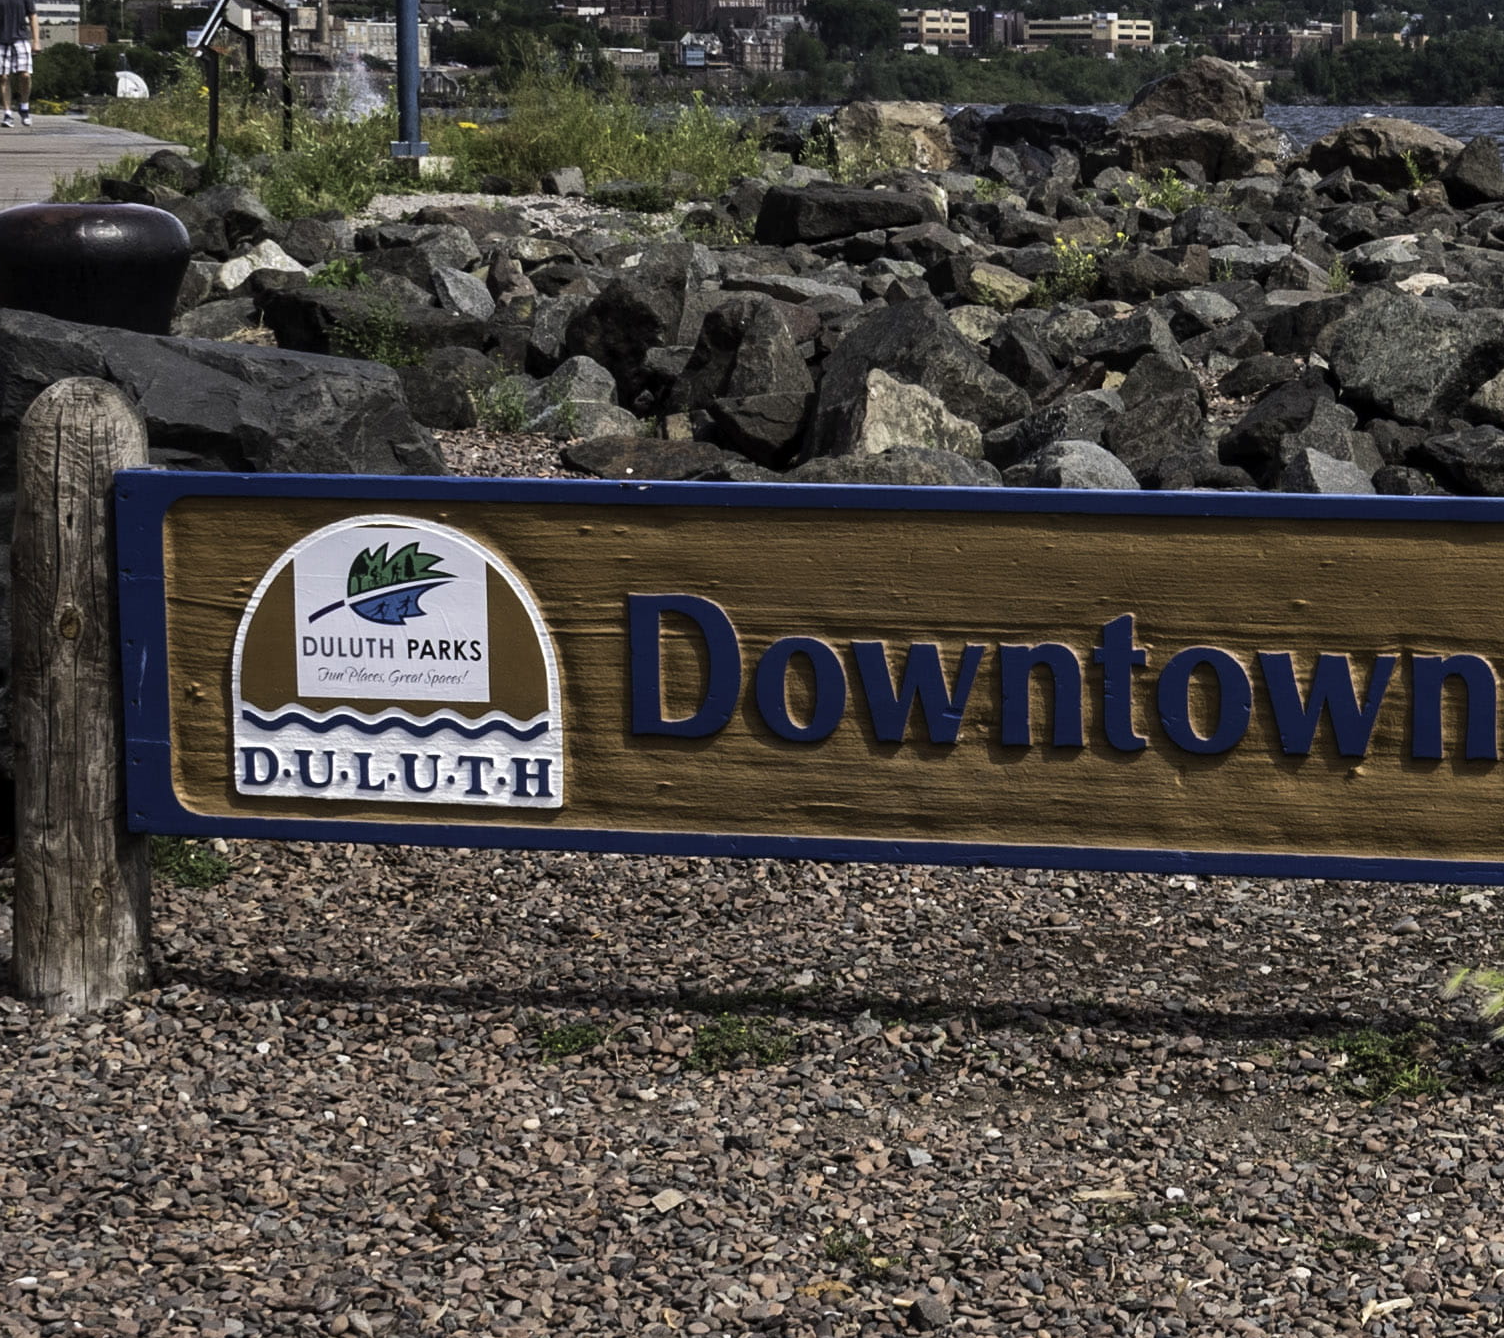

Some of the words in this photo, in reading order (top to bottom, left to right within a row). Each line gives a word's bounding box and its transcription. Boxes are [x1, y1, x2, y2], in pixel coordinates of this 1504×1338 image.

[302, 636, 394, 659] DULUTH
[407, 638, 482, 662] PARKS
[318, 666, 345, 683] Fun
[388, 669, 423, 687] Great
[424, 669, 469, 687] Spaces!
[628, 591, 1500, 760] Downtown
